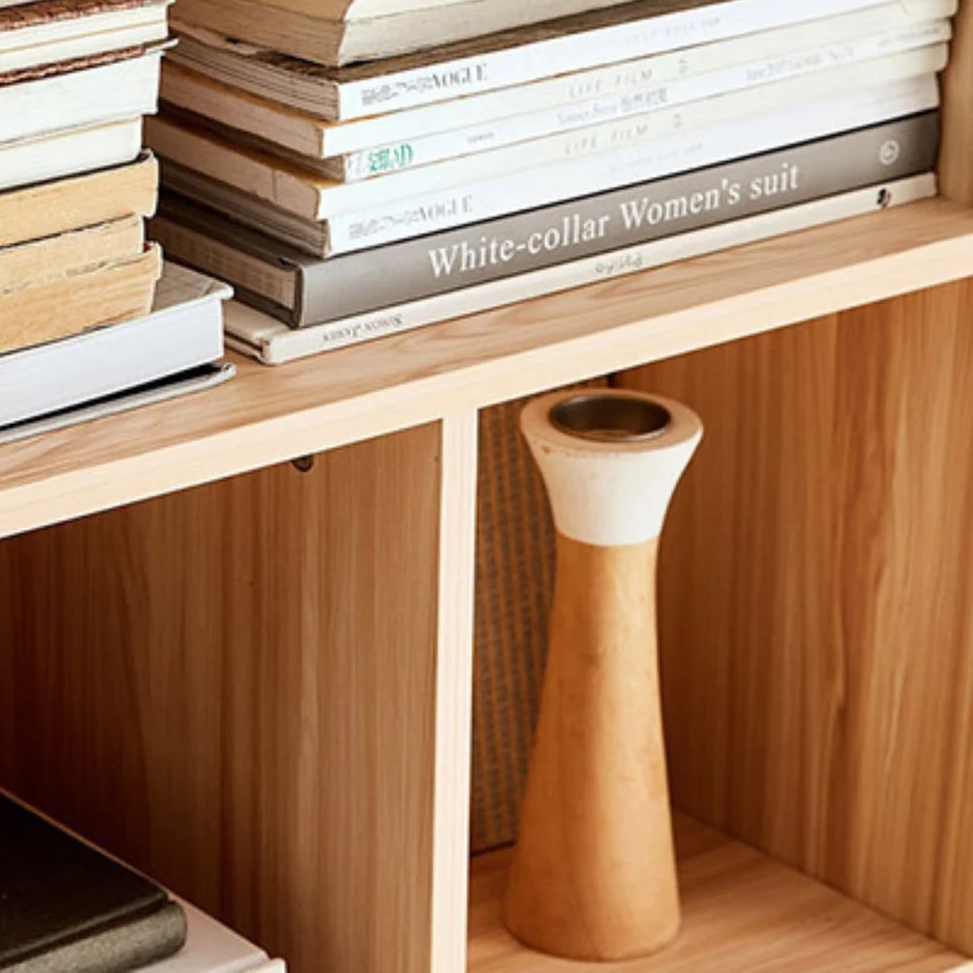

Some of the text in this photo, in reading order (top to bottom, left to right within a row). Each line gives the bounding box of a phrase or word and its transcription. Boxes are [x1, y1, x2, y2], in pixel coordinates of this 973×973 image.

[432, 63, 487, 89] VOGUE
[568, 68, 652, 98] LIFE FILM
[565, 124, 647, 154] LIFE FILM
[419, 194, 473, 220] VOGUE
[428, 214, 610, 278] White-collar
[619, 178, 741, 231] Women's
[750, 163, 800, 201] suit
